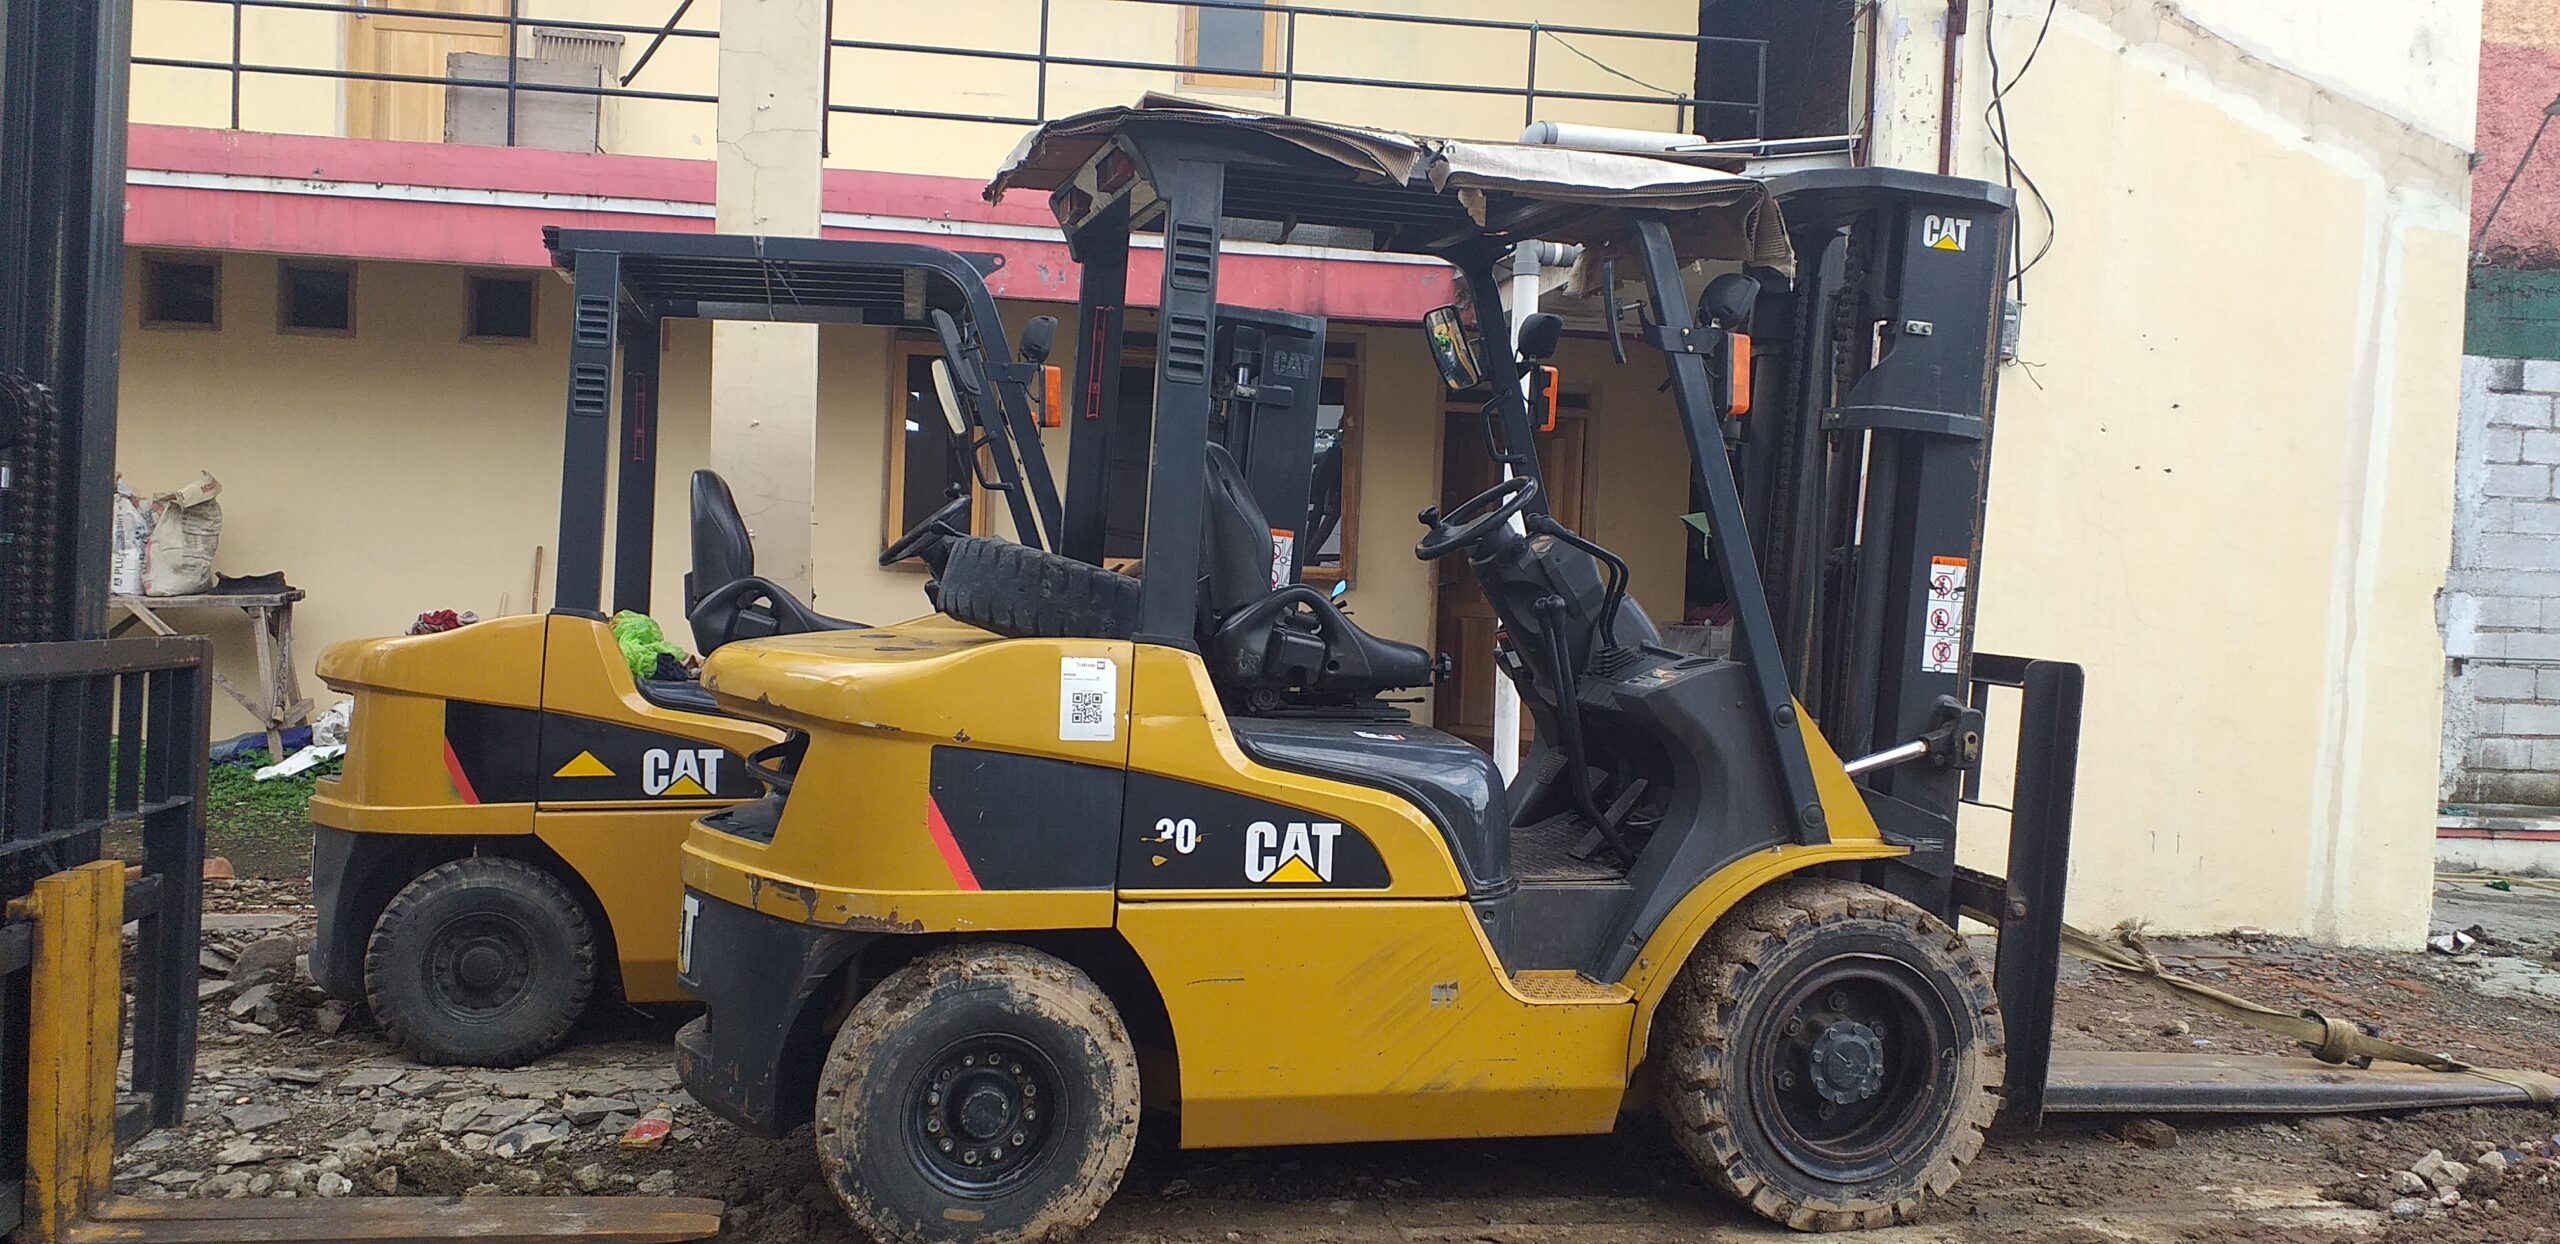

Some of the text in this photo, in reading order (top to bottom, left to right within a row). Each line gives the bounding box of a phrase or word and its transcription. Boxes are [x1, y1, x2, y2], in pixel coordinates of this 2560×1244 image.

[1923, 214, 1971, 251] CAT
[1273, 350, 1314, 379] CAT
[643, 748, 724, 796] CAT
[1245, 821, 1342, 883] CAT
